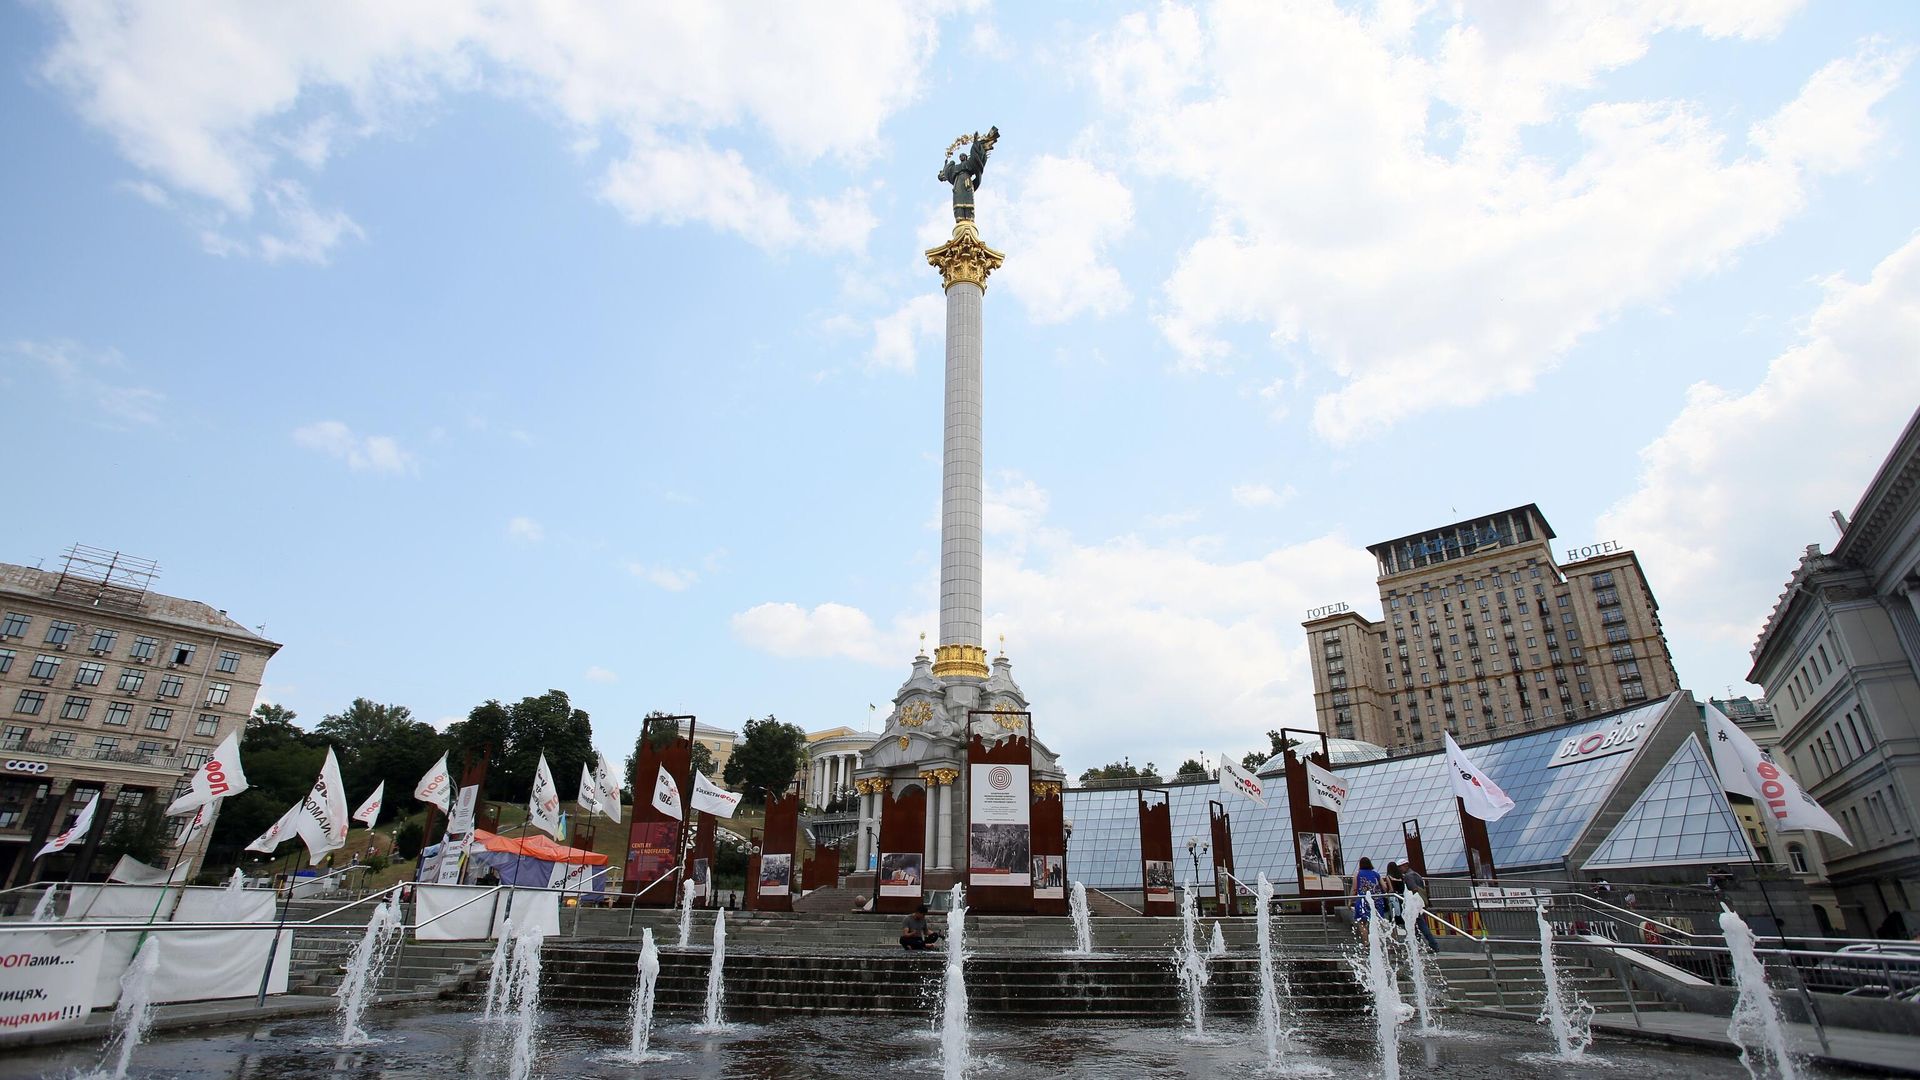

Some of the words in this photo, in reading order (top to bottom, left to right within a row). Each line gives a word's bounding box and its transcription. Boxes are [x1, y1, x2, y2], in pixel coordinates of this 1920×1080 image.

[1567, 540, 1623, 561] HOTEL
[1307, 601, 1350, 619] ГОТЕЛЬ
[1560, 722, 1645, 759] GLOBUS
[5, 760, 48, 775] coop
